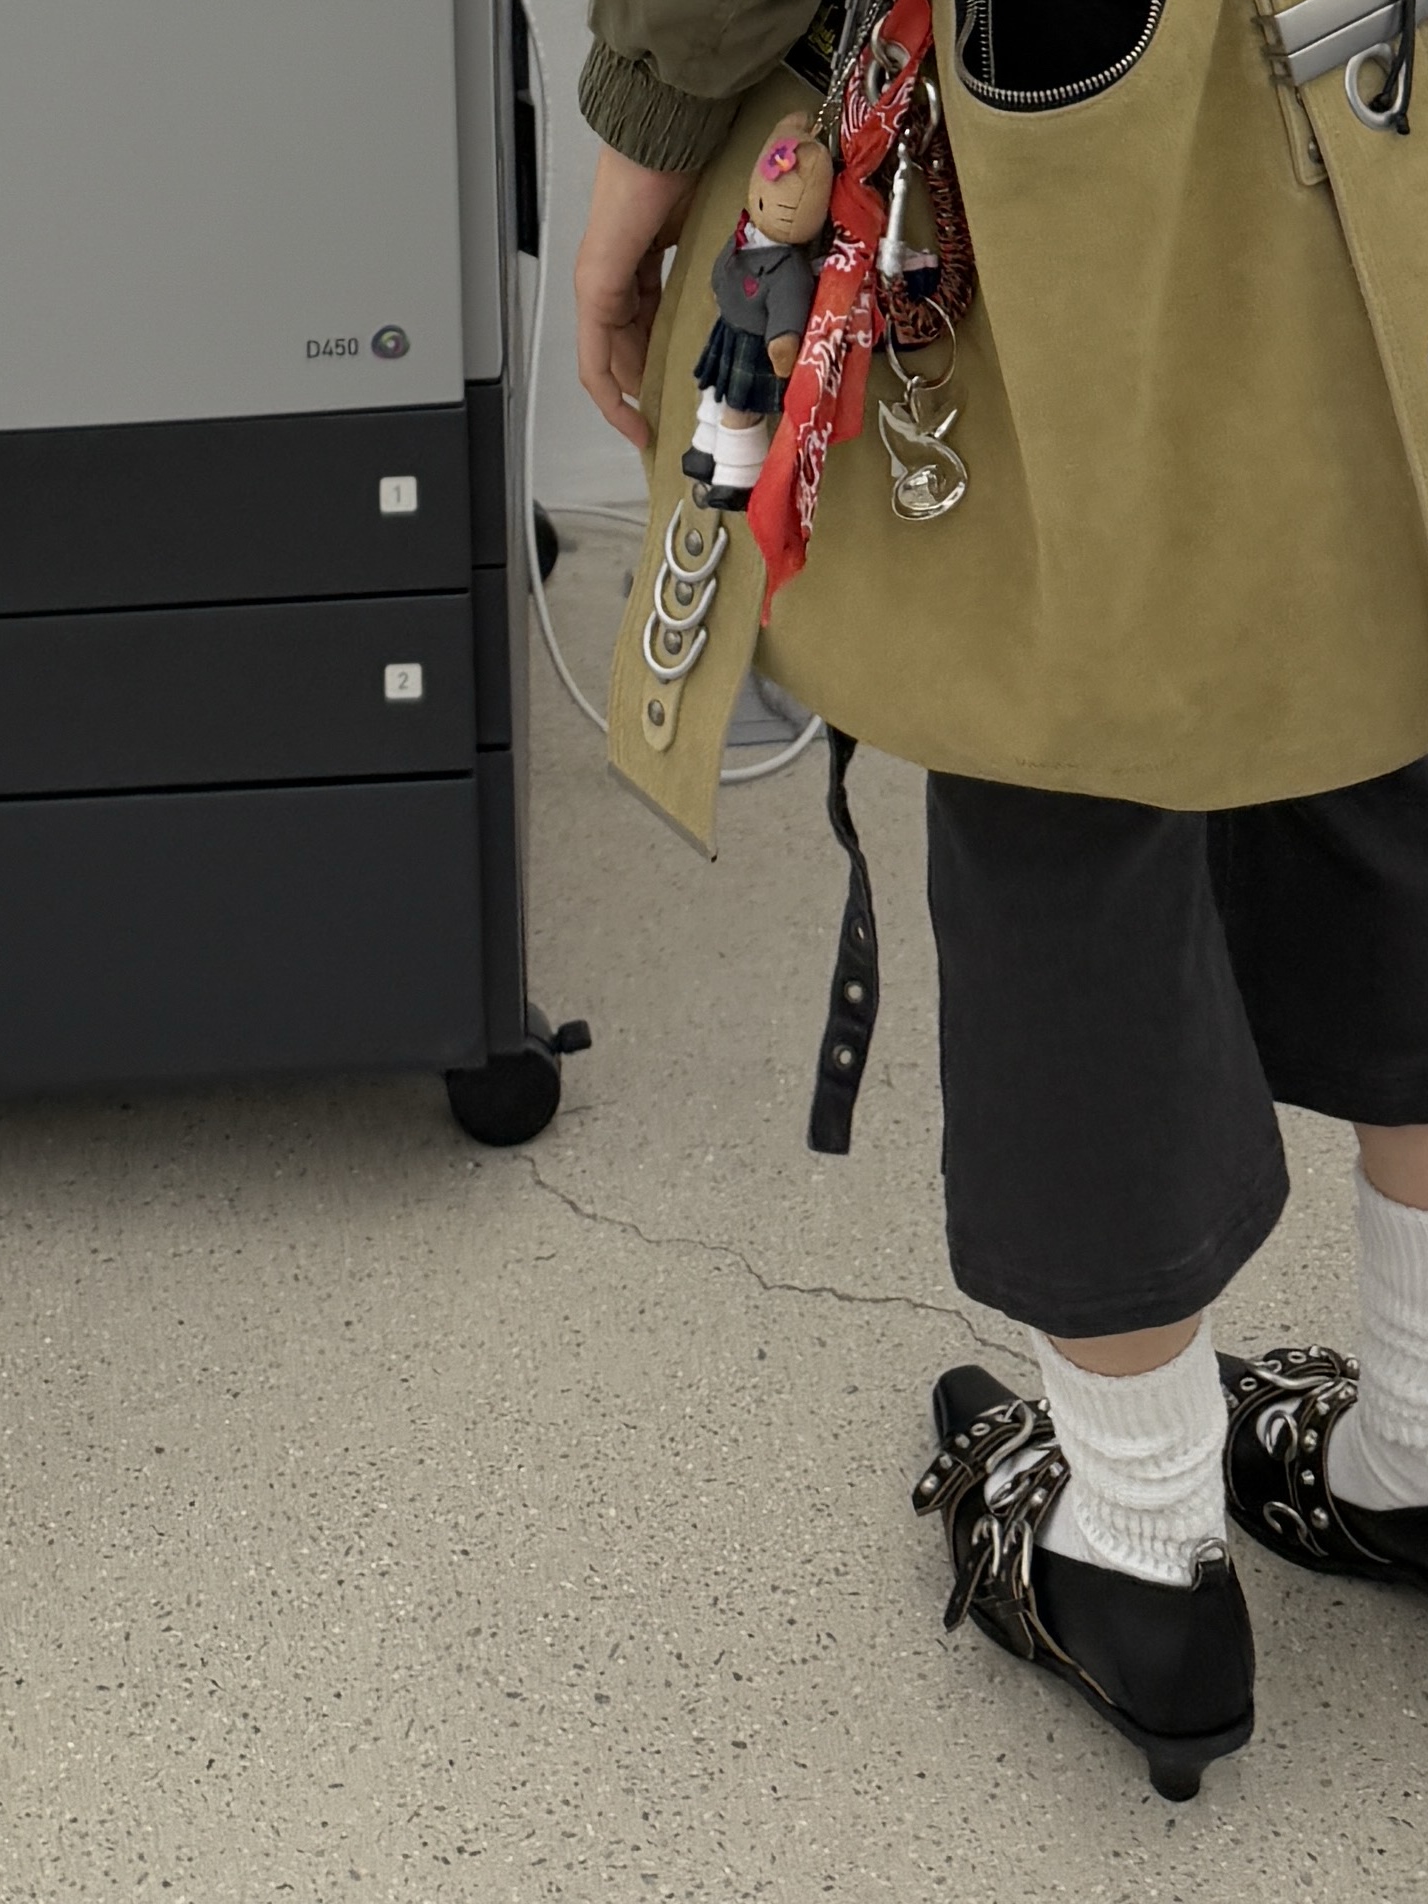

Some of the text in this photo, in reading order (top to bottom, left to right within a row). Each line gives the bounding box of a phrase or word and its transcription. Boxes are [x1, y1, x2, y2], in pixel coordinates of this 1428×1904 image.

[306, 337, 359, 359] D450
[392, 485, 401, 504] 1
[397, 671, 409, 690] 2
